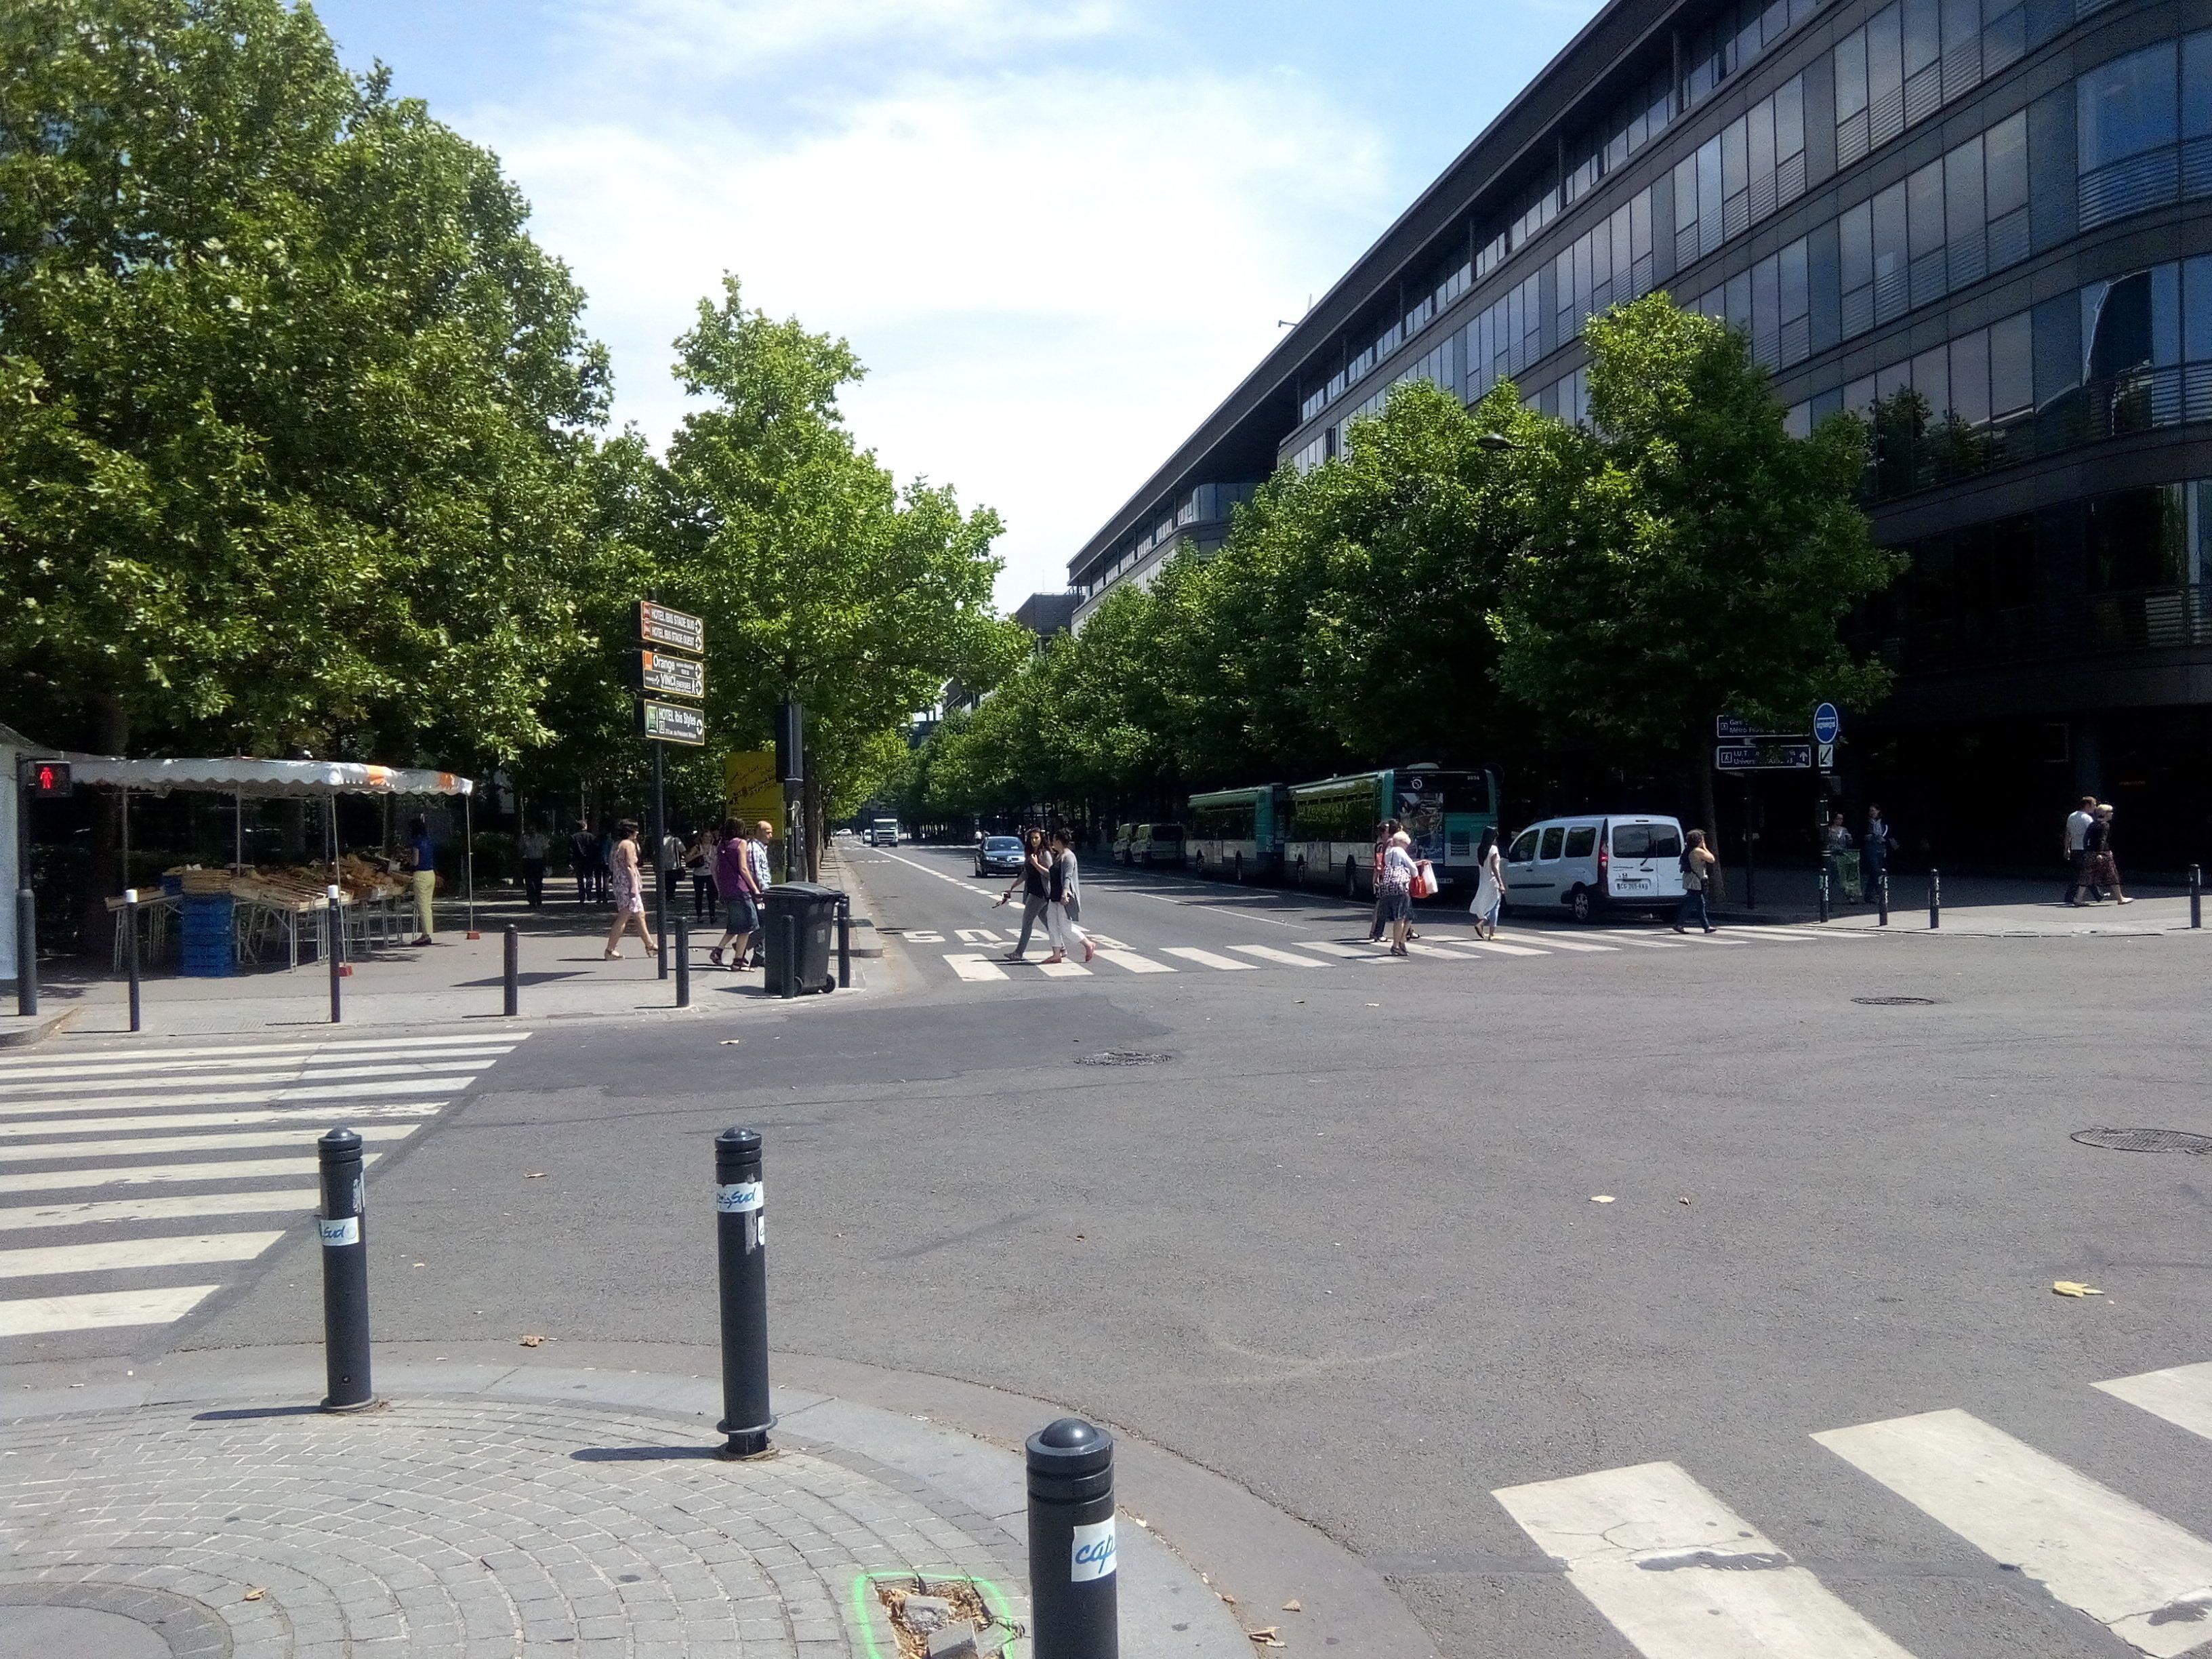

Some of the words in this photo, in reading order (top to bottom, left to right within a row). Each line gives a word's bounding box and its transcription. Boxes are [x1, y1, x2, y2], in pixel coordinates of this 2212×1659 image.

[653, 655, 676, 673] Orange
[660, 673, 676, 687] VINCI
[658, 707, 674, 722] HOTEL
